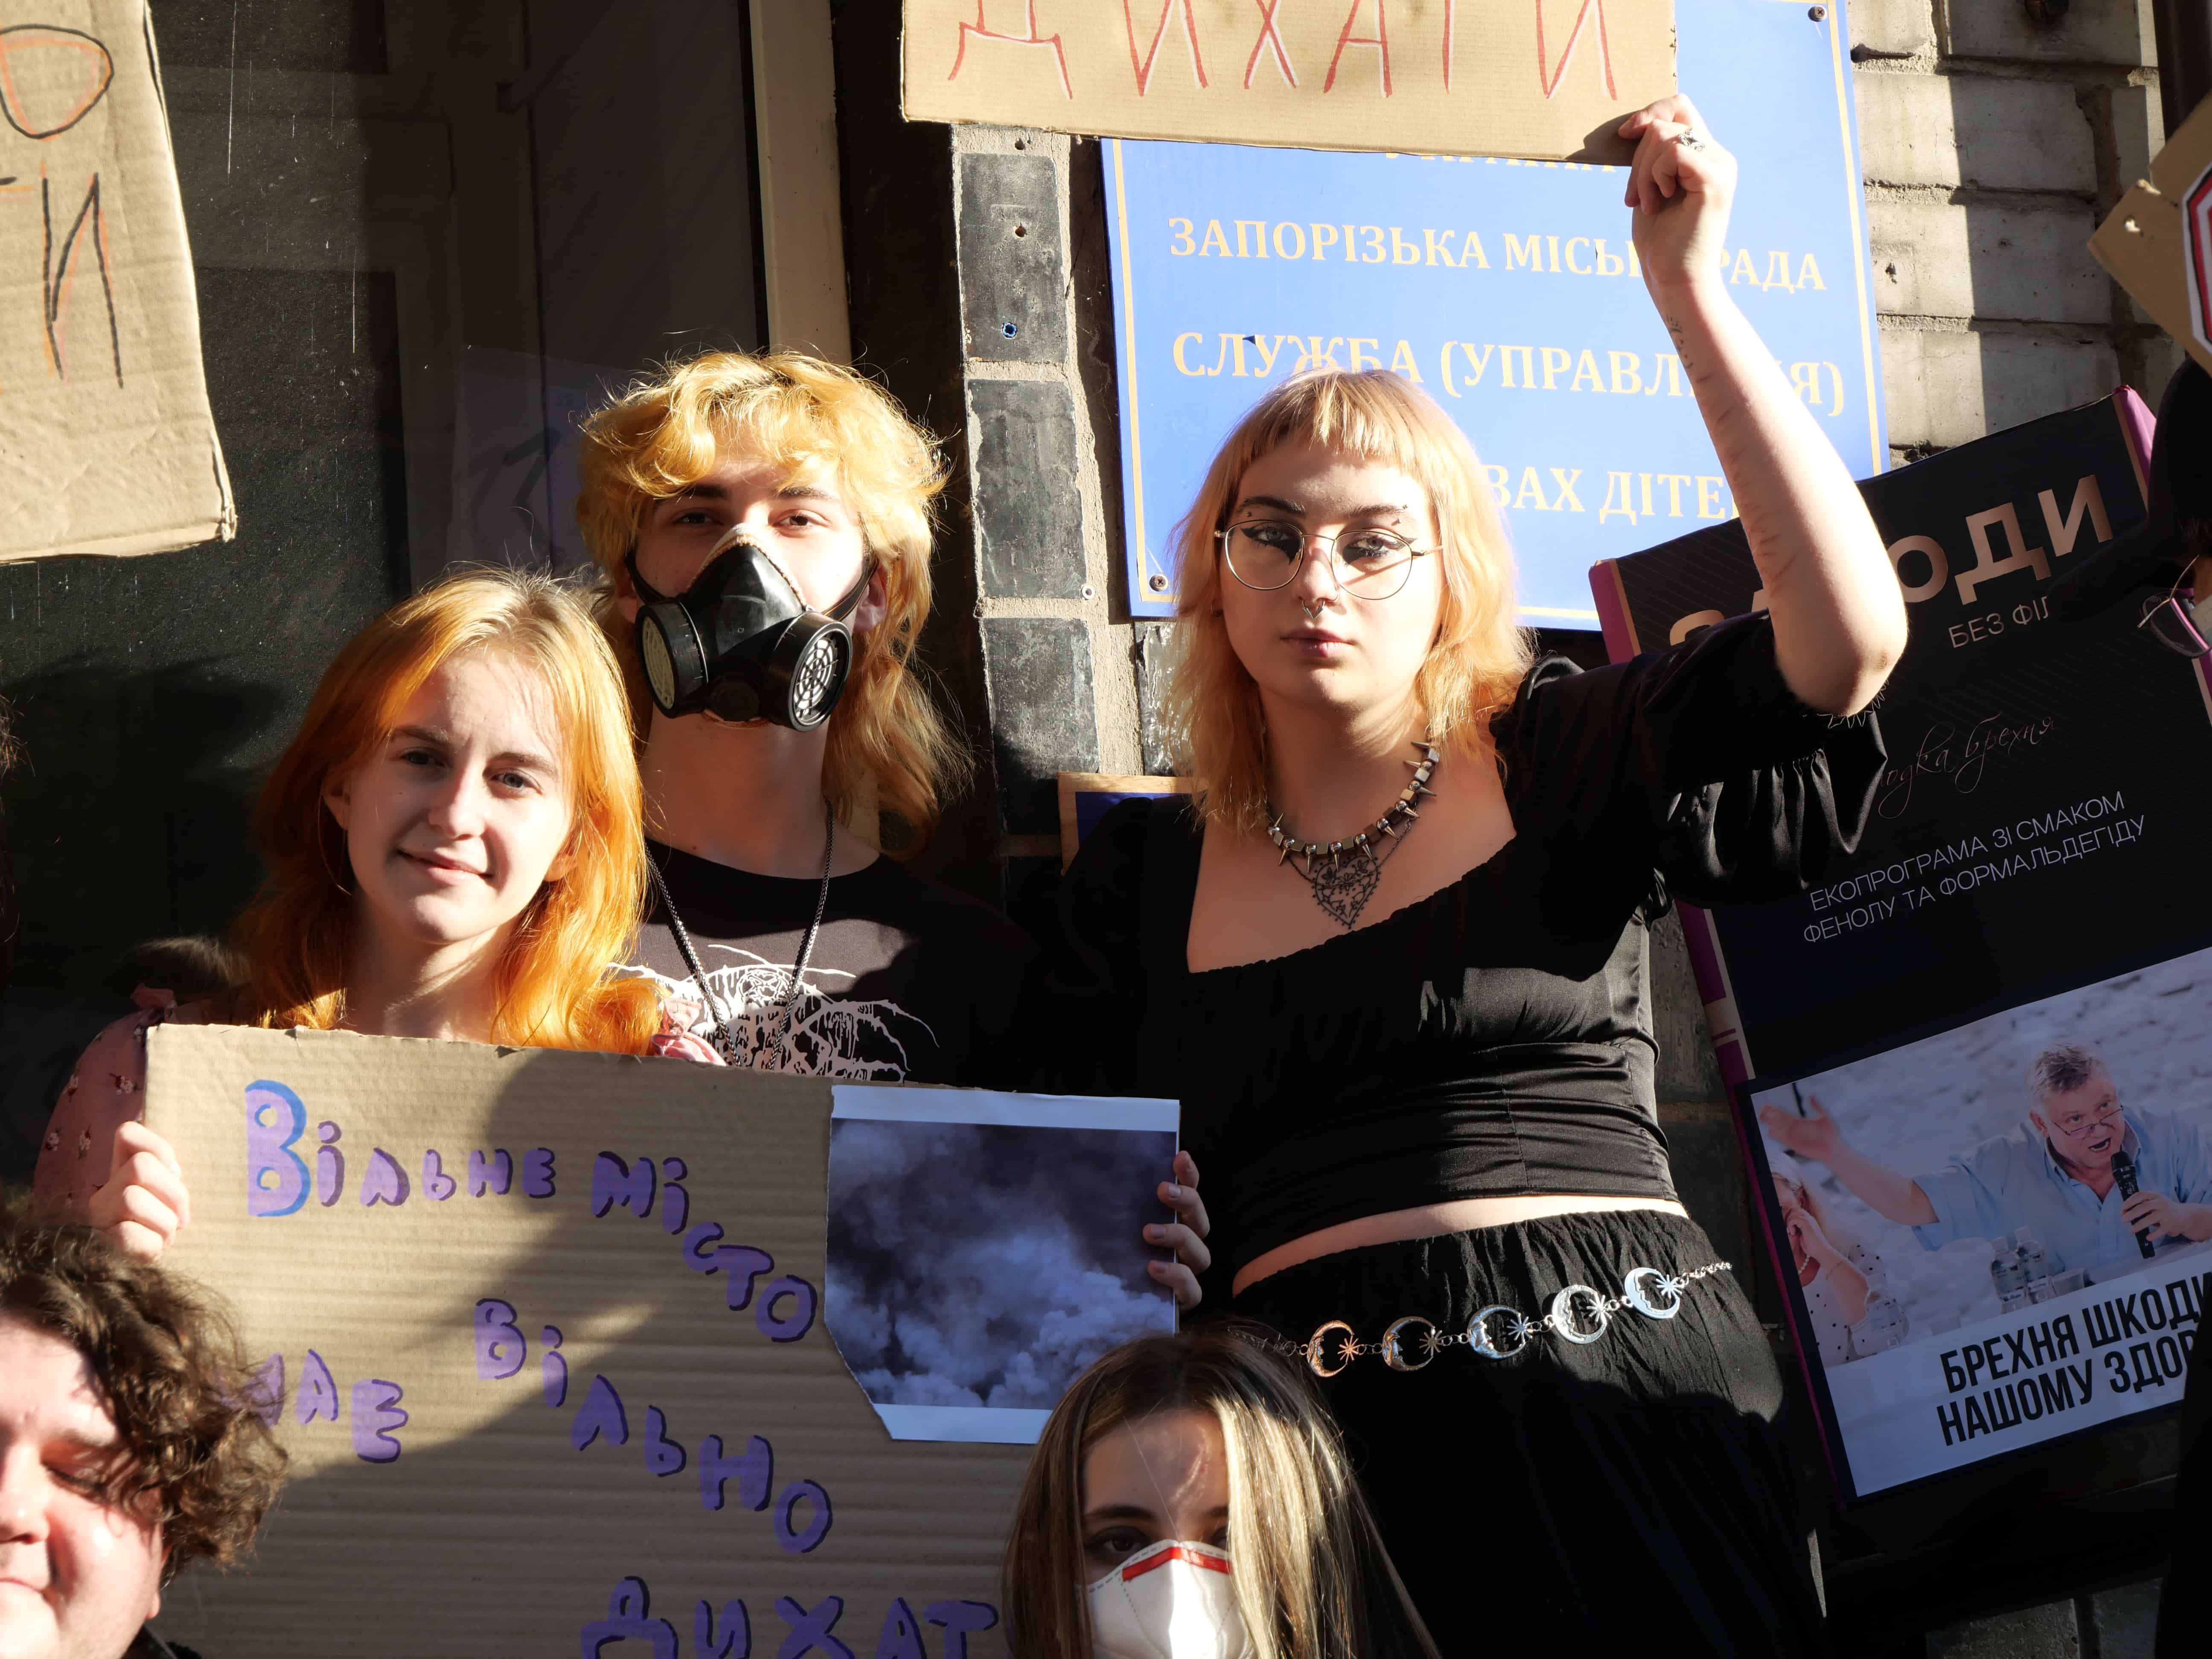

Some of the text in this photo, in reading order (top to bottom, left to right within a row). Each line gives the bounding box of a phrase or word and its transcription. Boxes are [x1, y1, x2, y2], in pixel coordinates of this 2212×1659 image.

[1168, 217, 1491, 269] ЗАПОРІЗЬКА
[1172, 332, 1424, 383] СЛУЖБА
[1948, 612, 2005, 649] БЕЗ
[1803, 814, 2145, 943] ФЕНОЛУ ТА ФОРМАЛЬДЕГІДУ
[1810, 790, 2125, 912] ЕКОПРОГРАМА ЗІ СМАКОМ
[1939, 1313, 2078, 1394] БРЕХНЯ
[1935, 1365, 2094, 1447] НАШОМУ
